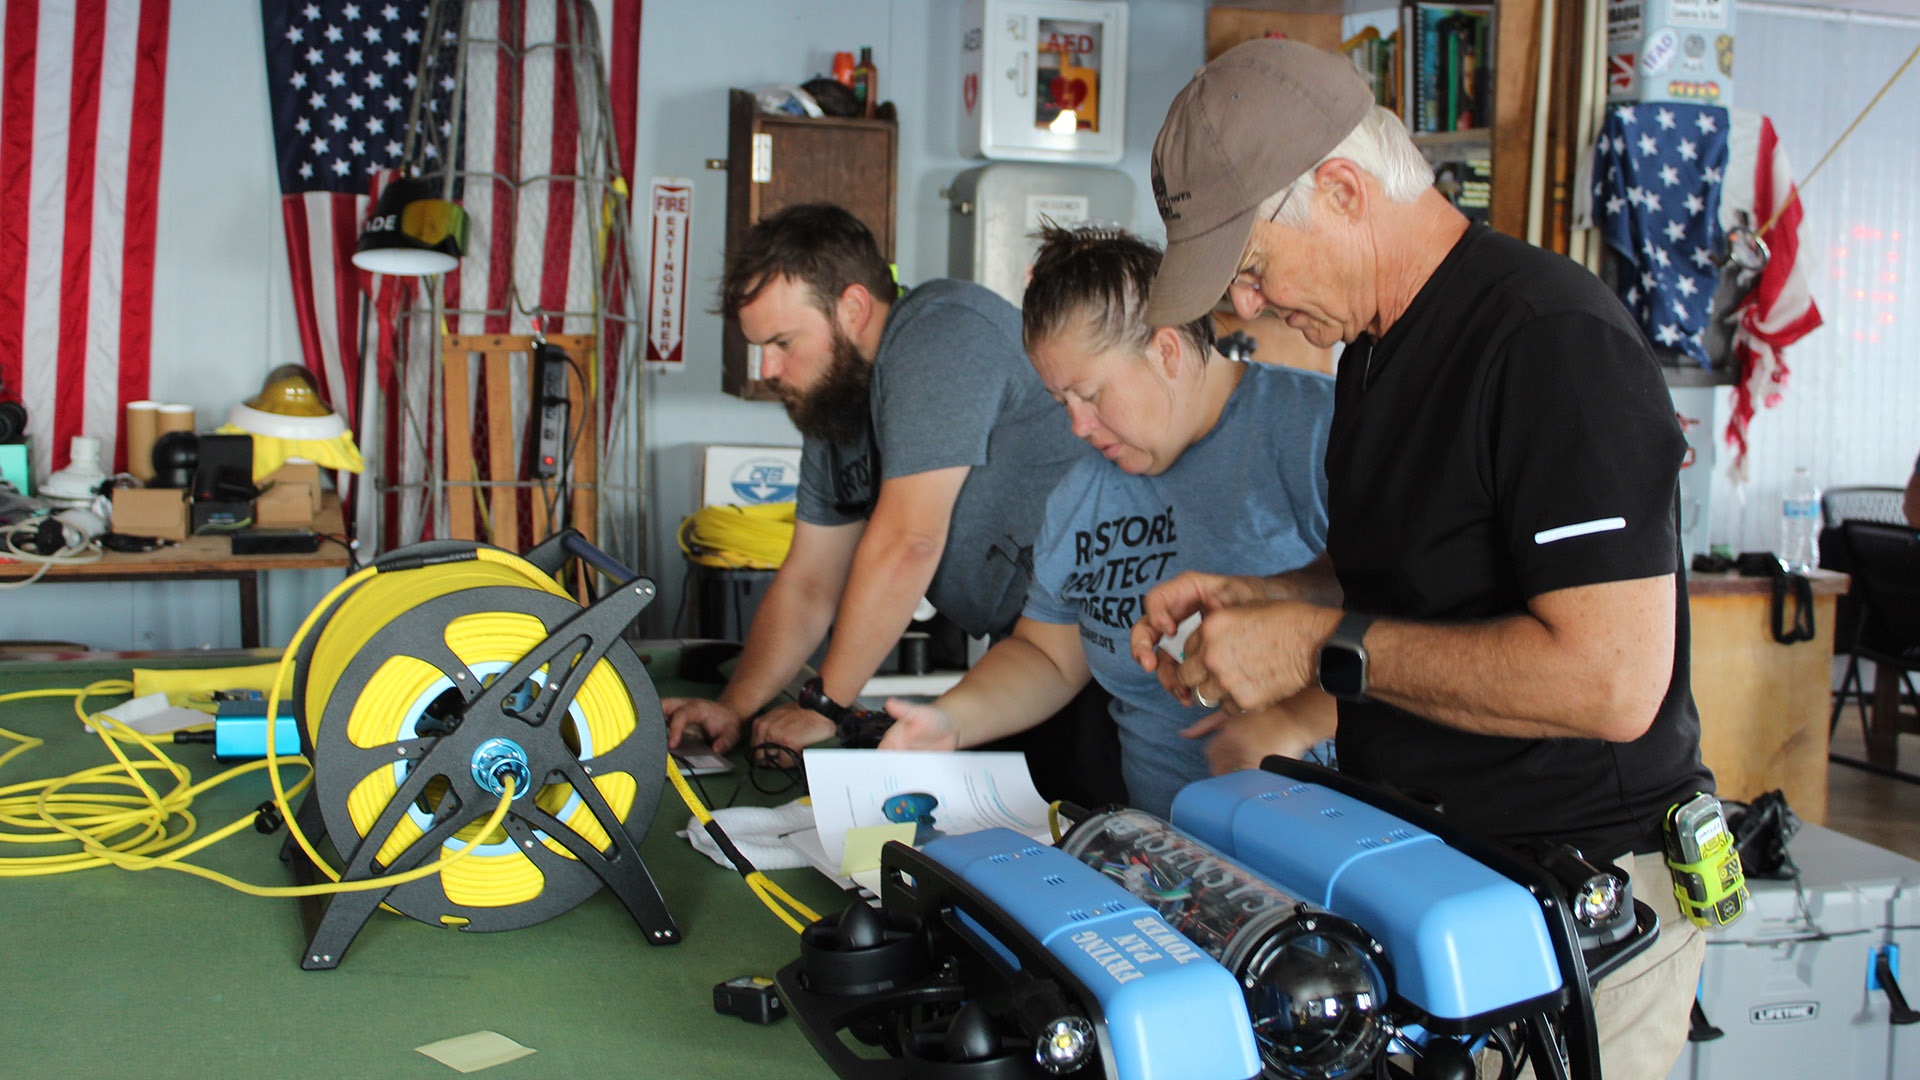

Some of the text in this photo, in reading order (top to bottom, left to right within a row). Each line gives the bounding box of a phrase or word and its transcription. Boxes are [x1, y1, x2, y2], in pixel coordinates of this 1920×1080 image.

[1047, 33, 1094, 54] AED
[656, 195, 687, 213] FIRE
[660, 216, 676, 352] EXTINGUISHER
[1075, 505, 1177, 566] RSTORE
[1071, 931, 1144, 984] FRYING
[1112, 933, 1163, 964] PAN
[1133, 917, 1201, 964] TOWER
[1754, 1005, 1814, 1020] LIFETIME
